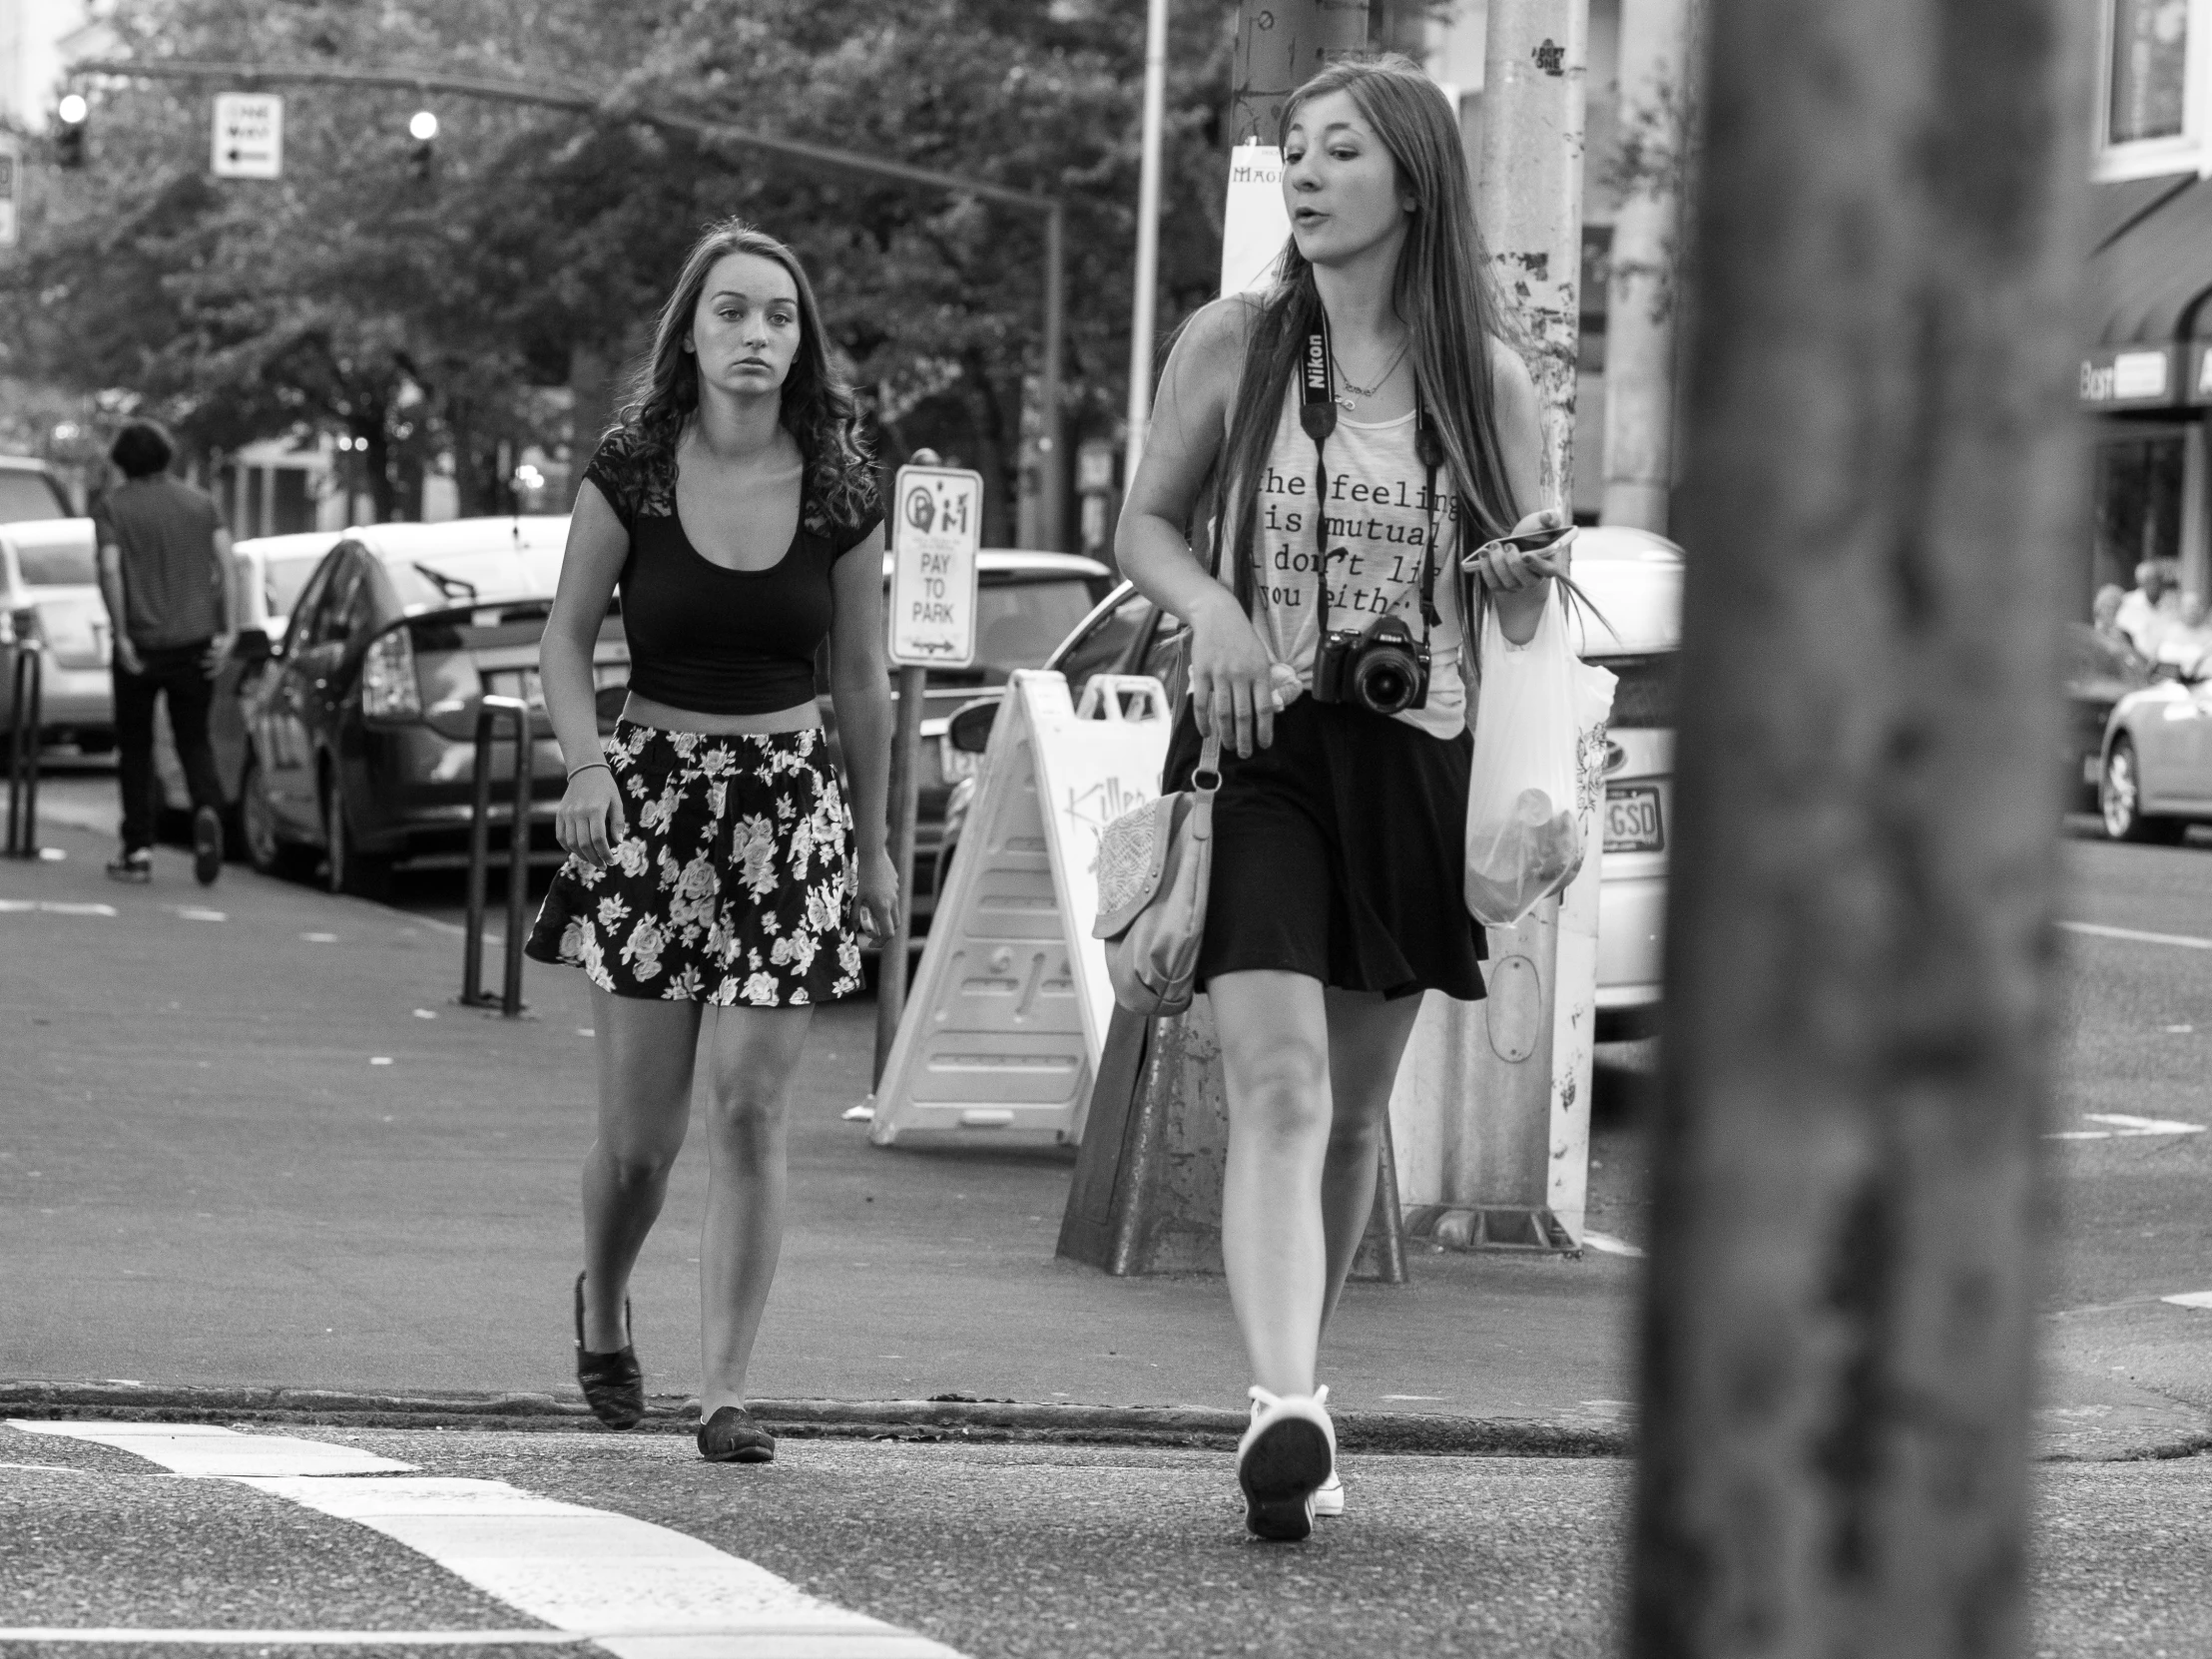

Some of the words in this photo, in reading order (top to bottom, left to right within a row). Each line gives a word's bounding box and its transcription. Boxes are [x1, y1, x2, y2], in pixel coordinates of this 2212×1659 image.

[1307, 334, 1326, 388] Nikon
[1258, 466, 1306, 496] he
[1330, 473, 1457, 522] feeling
[1265, 503, 1303, 533] is
[1325, 516, 1439, 549] mutual
[920, 552, 951, 575] PAY
[924, 577, 946, 599] TO
[911, 601, 954, 624] PARK
